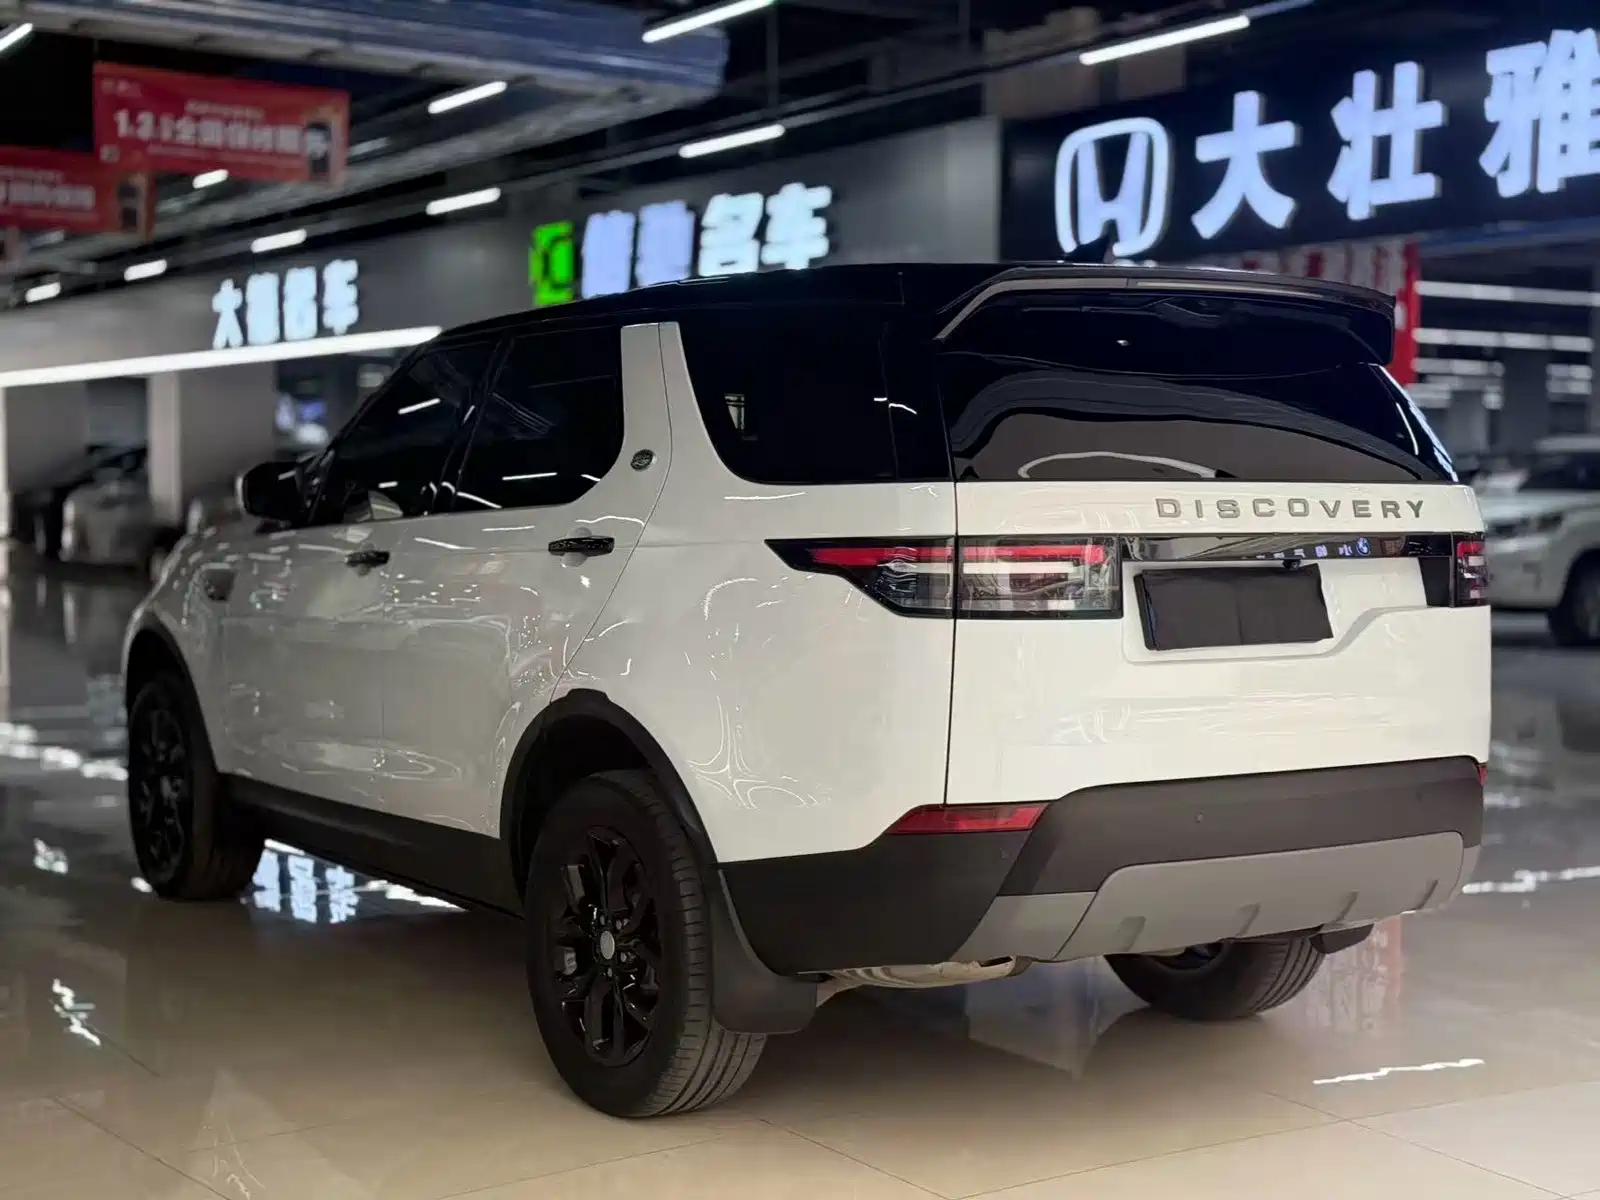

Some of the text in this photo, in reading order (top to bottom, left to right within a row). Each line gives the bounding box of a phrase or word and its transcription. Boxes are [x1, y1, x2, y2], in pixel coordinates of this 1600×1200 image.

[1191, 27, 1600, 239] 大壮雅
[581, 182, 832, 299] 名车
[212, 259, 359, 349] 大车
[1155, 498, 1424, 519] DISCOVERY
